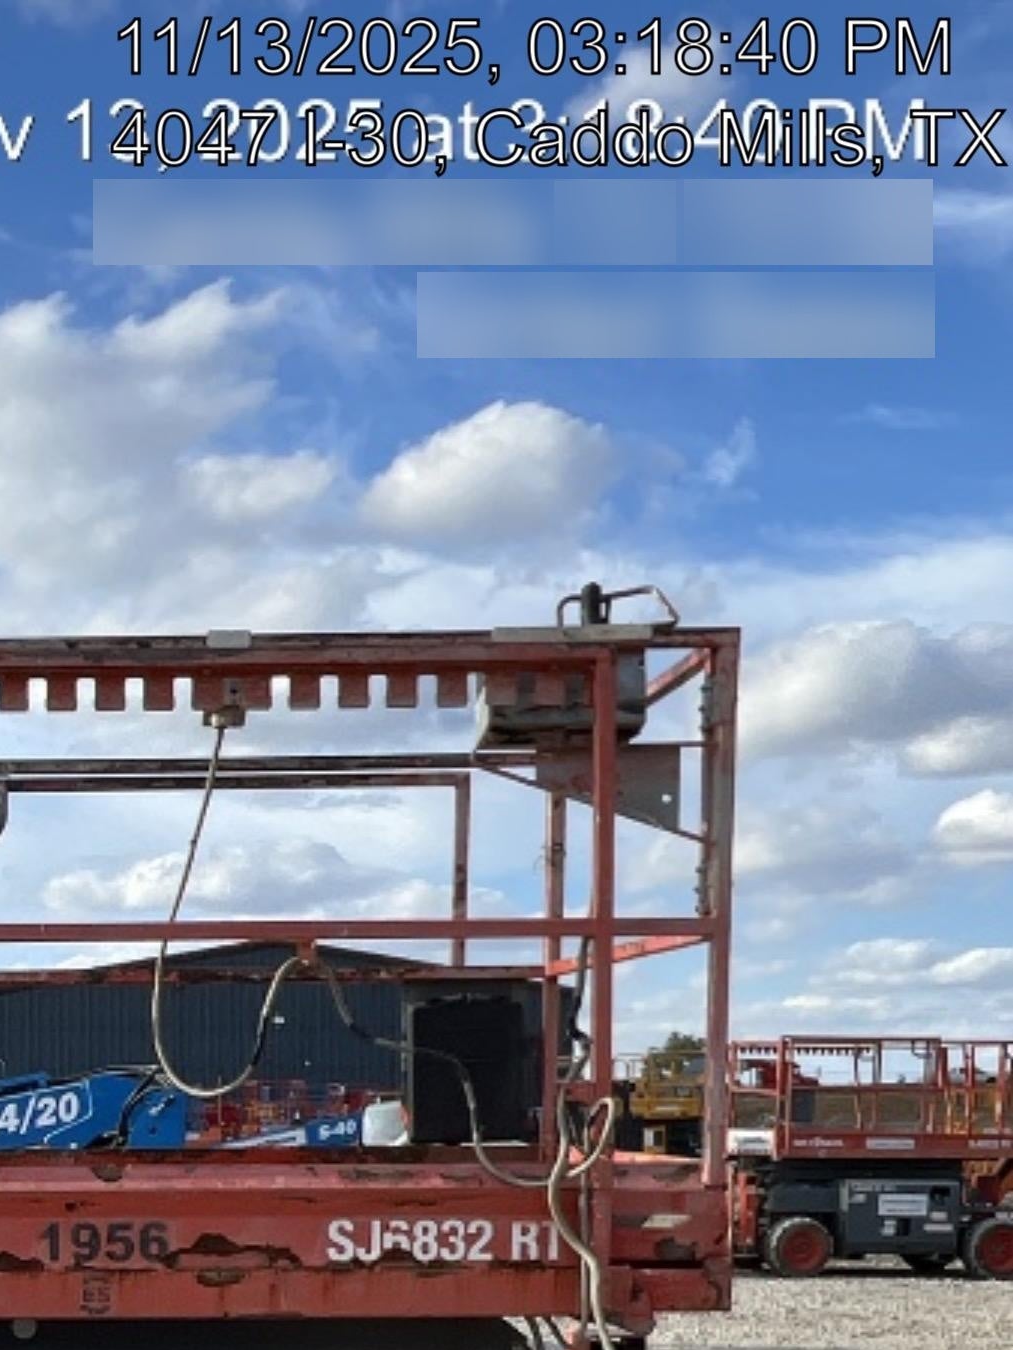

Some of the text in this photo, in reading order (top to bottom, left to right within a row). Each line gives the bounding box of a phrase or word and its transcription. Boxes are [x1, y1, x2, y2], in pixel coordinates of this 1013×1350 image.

[42, 1221, 170, 1264] 1956
[328, 1219, 559, 1262] SJ6832 RT
